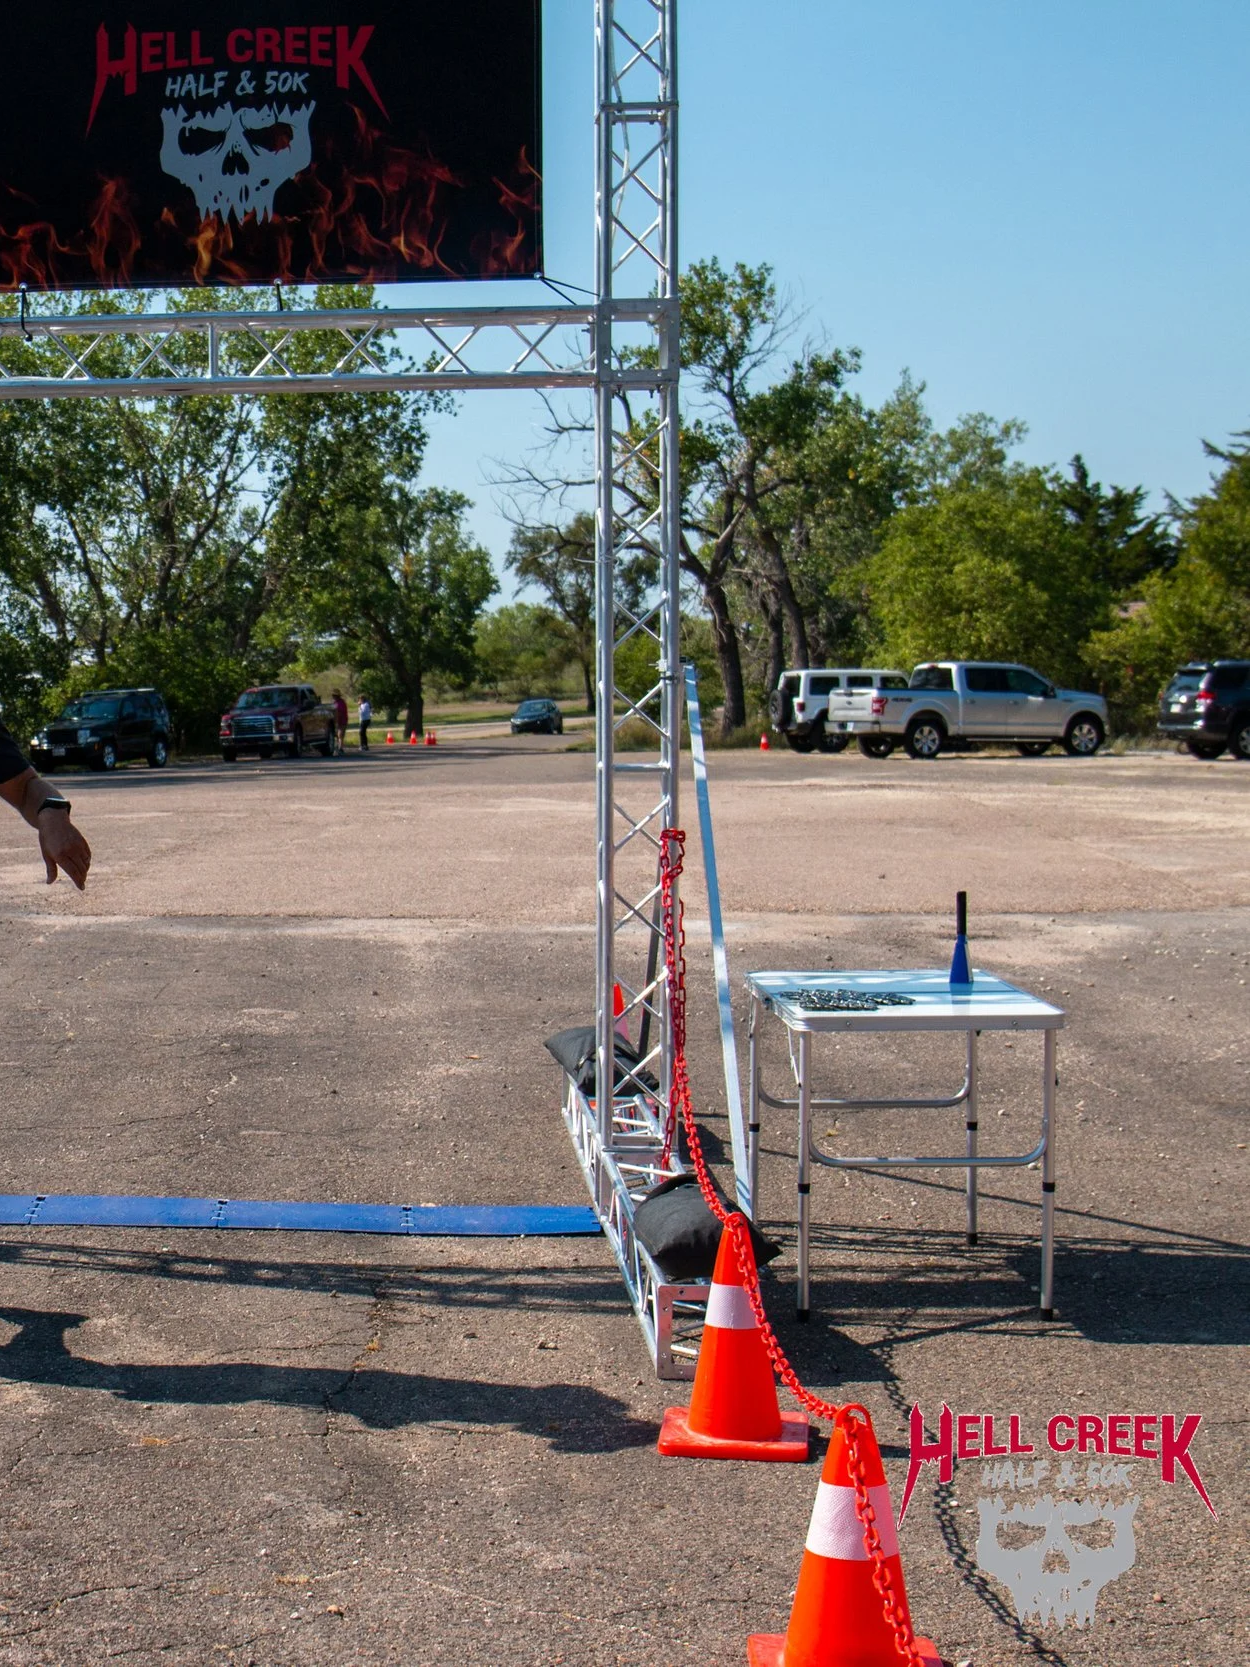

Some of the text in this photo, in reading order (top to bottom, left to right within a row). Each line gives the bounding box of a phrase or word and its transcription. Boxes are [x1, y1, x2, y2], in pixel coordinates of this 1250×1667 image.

[85, 20, 392, 138] HELL CREEK
[165, 70, 309, 99] HALF & 50K
